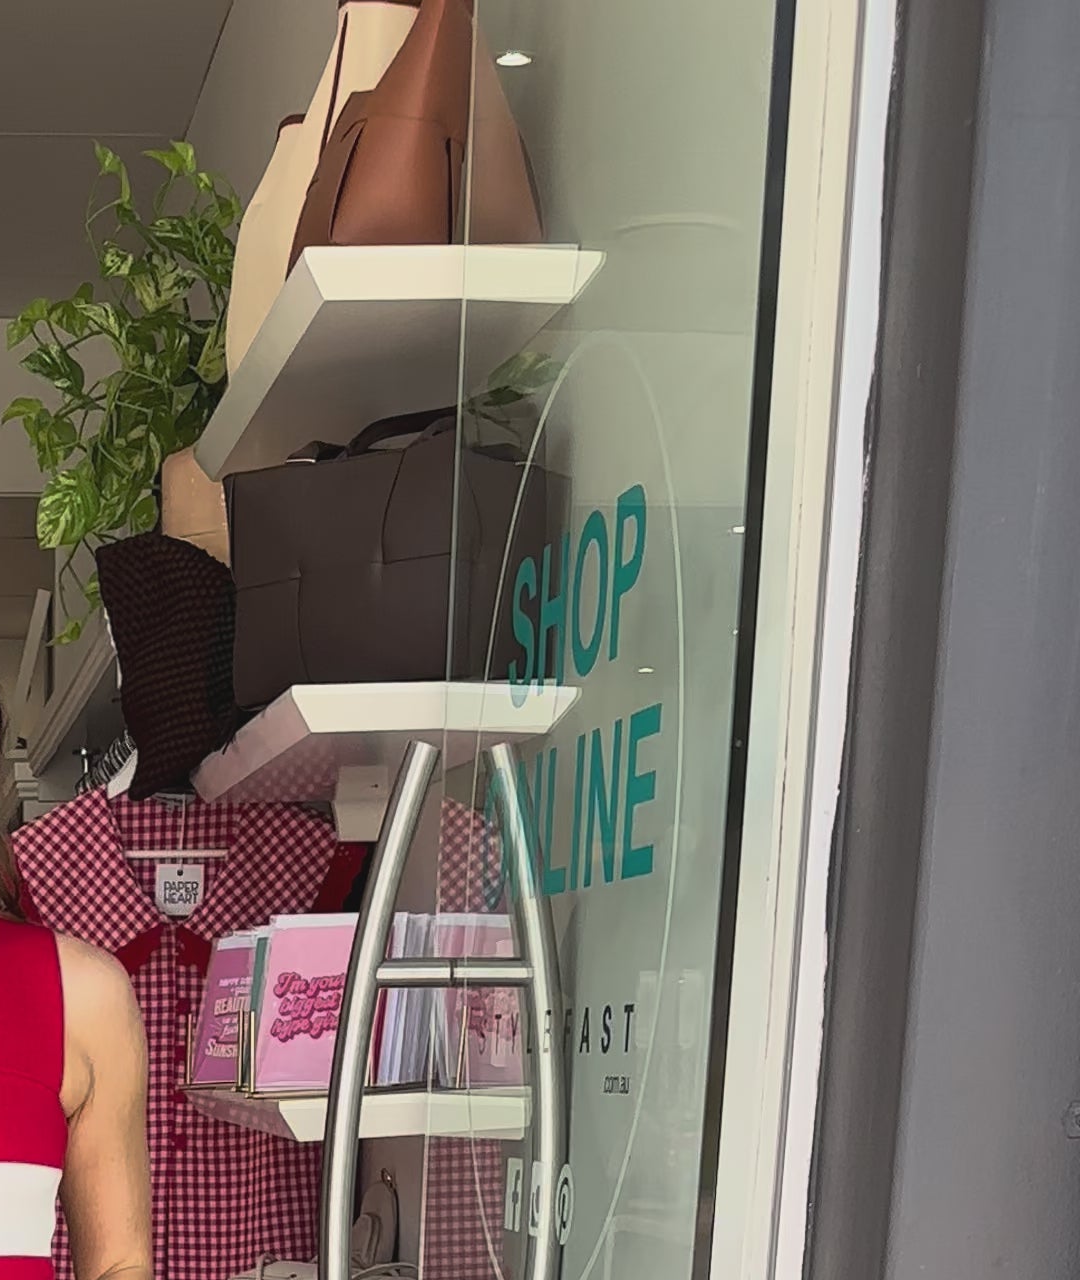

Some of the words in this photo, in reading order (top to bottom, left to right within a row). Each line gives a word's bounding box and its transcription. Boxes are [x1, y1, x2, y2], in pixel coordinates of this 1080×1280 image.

[508, 484, 646, 708] SHOP
[164, 881, 199, 892] PAPER
[164, 891, 199, 904] HEART
[273, 971, 309, 998] I'm
[278, 992, 341, 1020] biggest
[270, 1017, 313, 1043] hype
